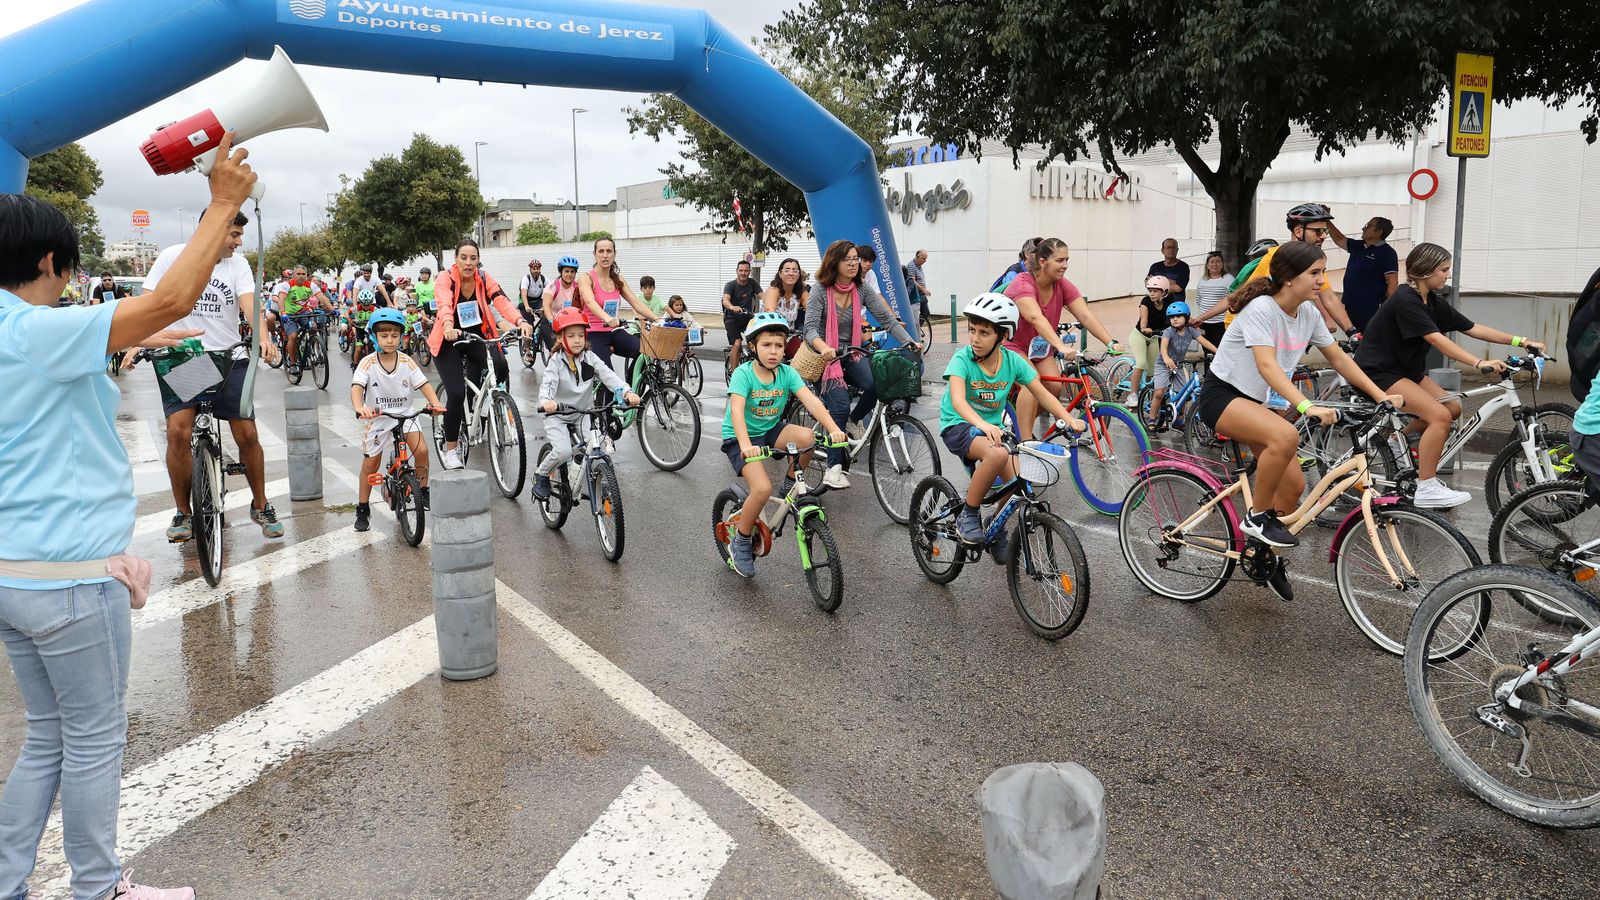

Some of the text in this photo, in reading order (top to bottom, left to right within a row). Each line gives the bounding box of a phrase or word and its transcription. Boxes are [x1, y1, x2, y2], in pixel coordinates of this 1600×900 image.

[338, 11, 443, 33] Deportes
[339, 0, 664, 41] Ayuntamiento de Jerez
[1460, 74, 1488, 88] ATENCIÓN
[1456, 137, 1485, 151] PEATONES
[1030, 165, 1144, 201] HIPERCOR
[193, 302, 221, 313] FITCH
[375, 396, 408, 405] Emirates
[751, 407, 779, 416] TEAM
